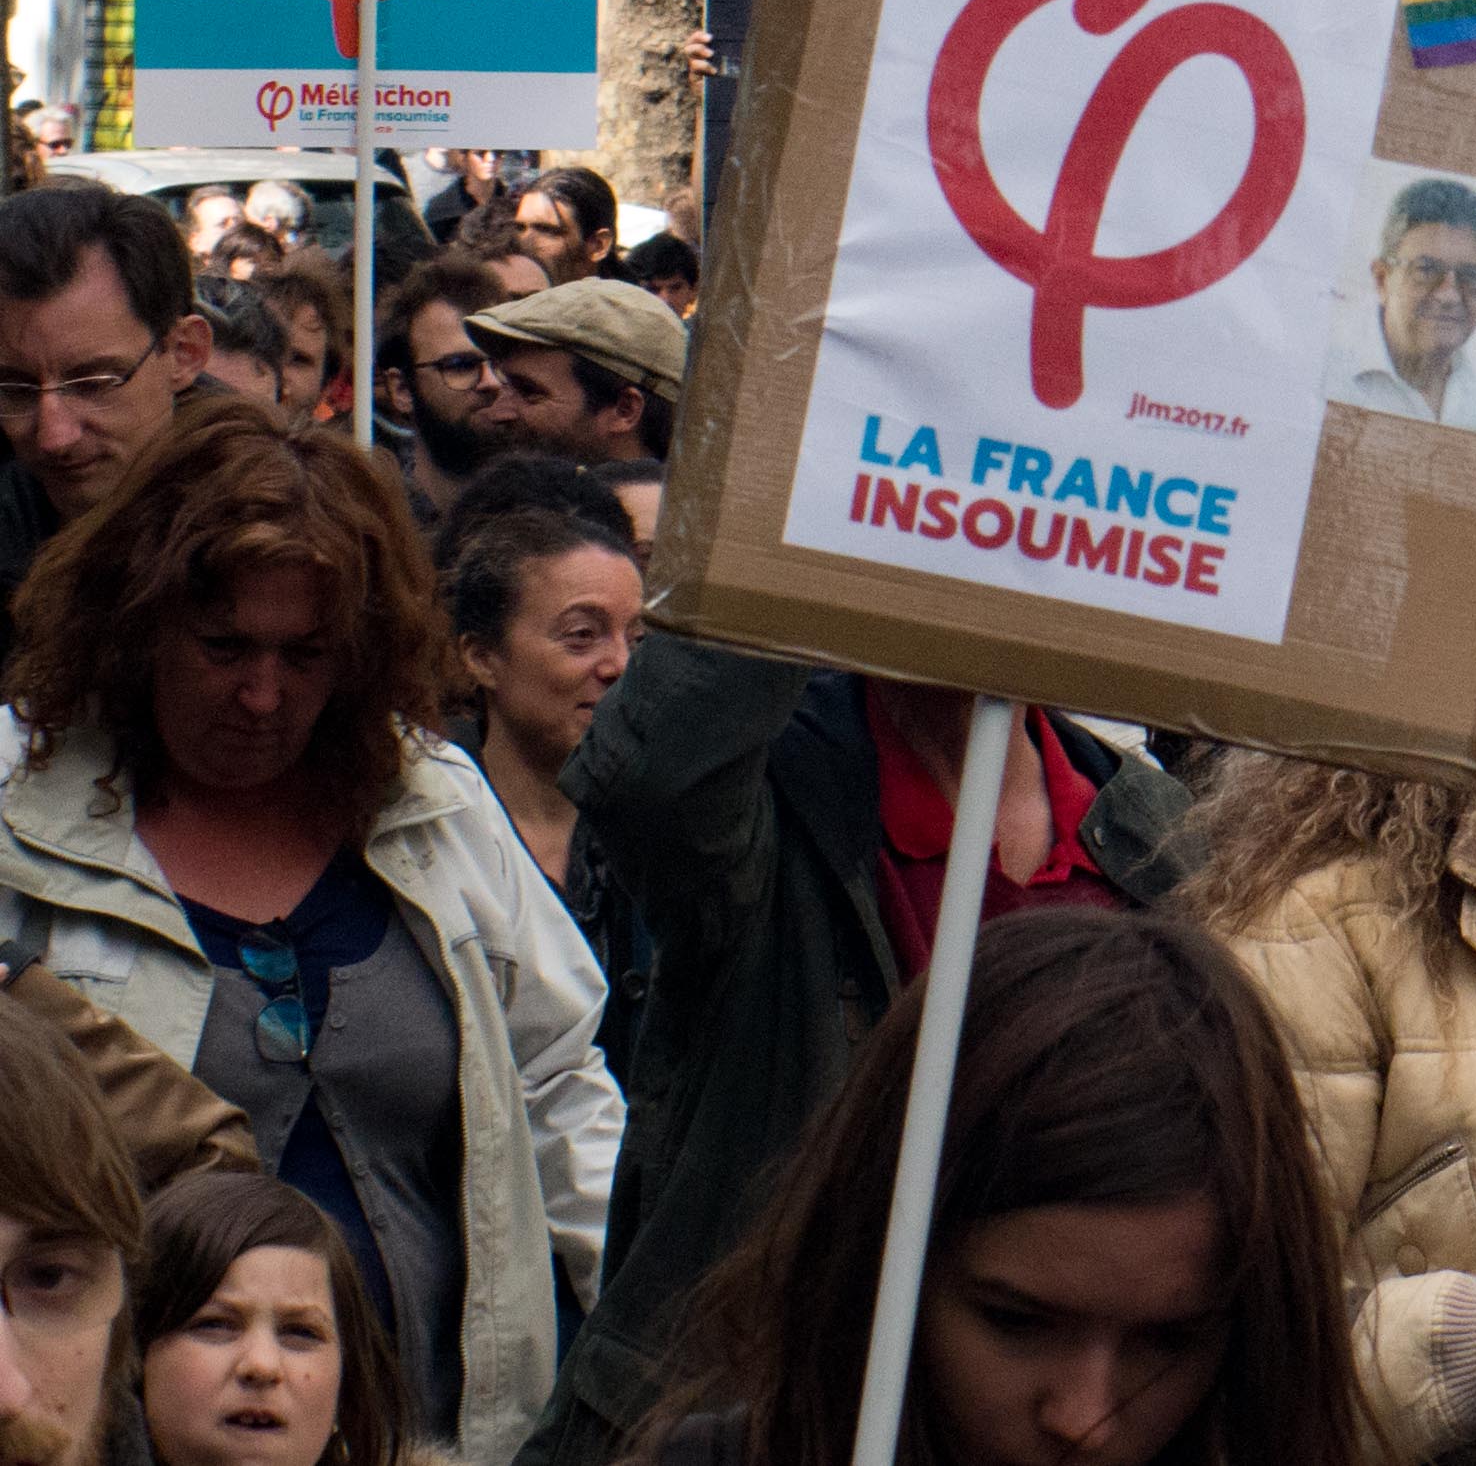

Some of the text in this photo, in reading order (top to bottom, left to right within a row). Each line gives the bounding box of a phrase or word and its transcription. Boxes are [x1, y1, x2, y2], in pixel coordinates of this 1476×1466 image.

[317, 109, 358, 122] Franc
[374, 110, 450, 122] nsoumise
[1125, 392, 1251, 438] jlm2017.fr
[859, 414, 1239, 536] LA FRANCE
[849, 473, 1227, 597] INSOUMISE
